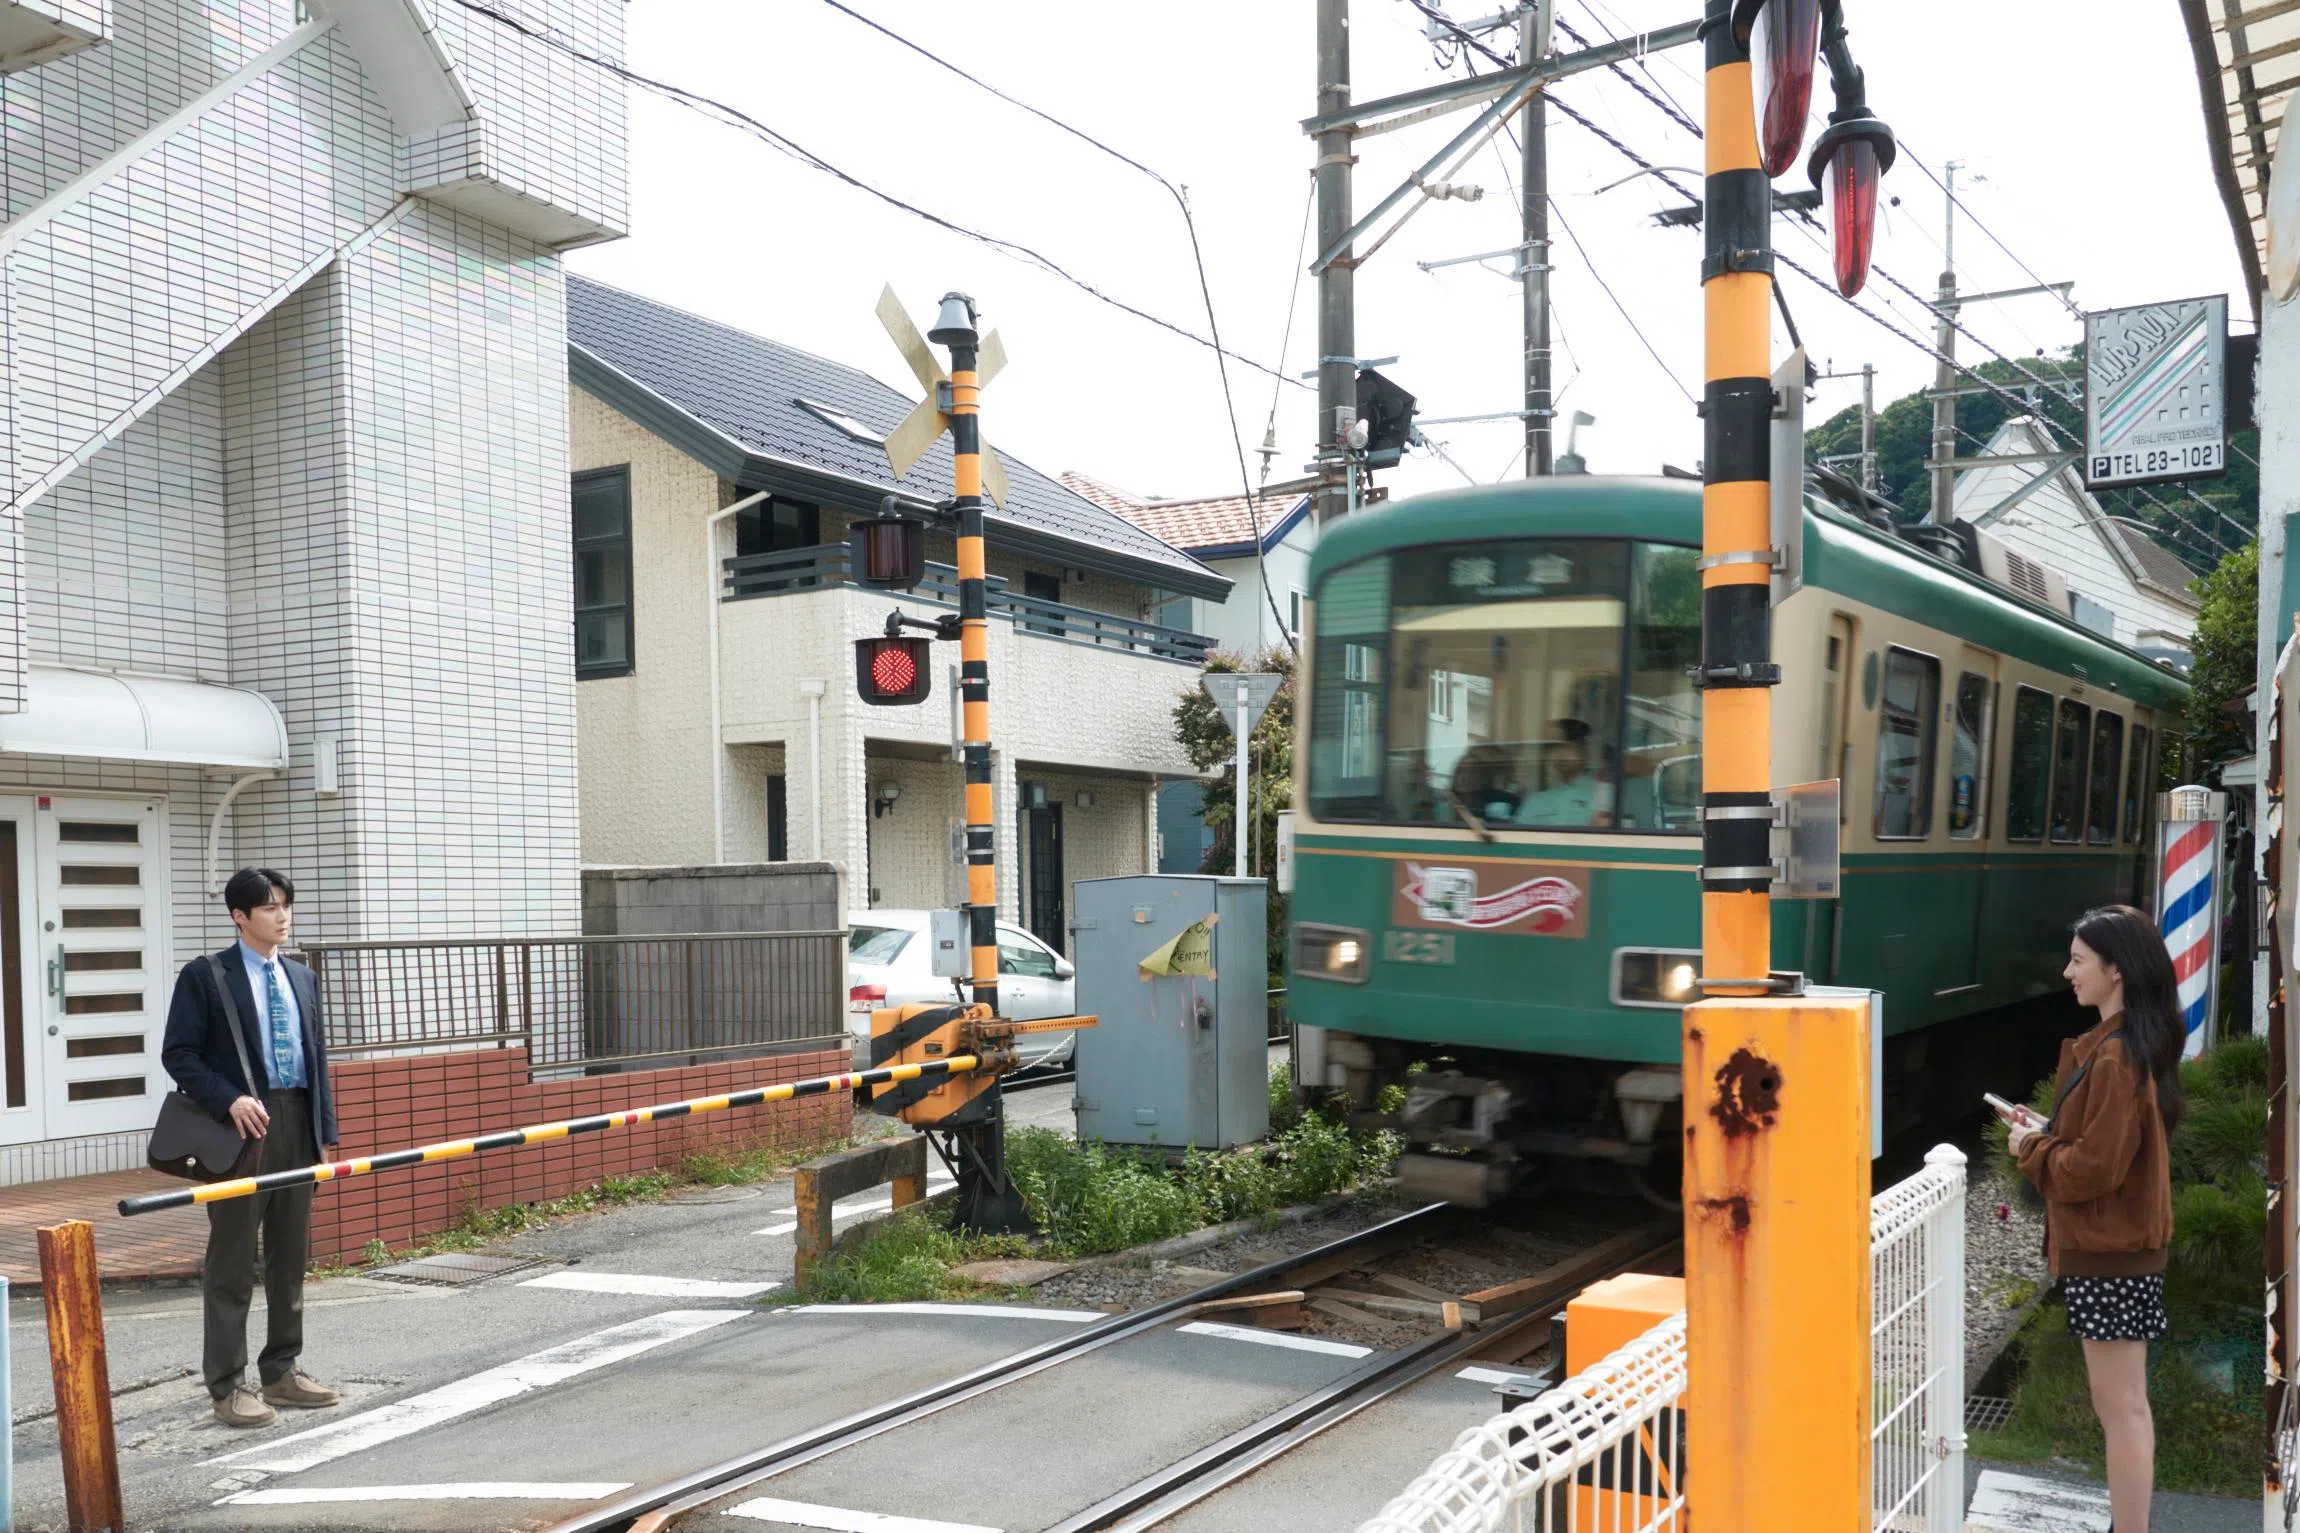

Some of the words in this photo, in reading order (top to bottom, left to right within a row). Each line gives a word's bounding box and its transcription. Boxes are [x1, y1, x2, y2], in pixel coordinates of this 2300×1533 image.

[2089, 346, 2140, 387] HAIR
[2124, 306, 2180, 355] SALON
[2095, 459, 2110, 477] P
[2114, 454, 2143, 475] TEL
[2147, 444, 2222, 472] 23-1021
[1177, 950, 1209, 964] ENTRY
